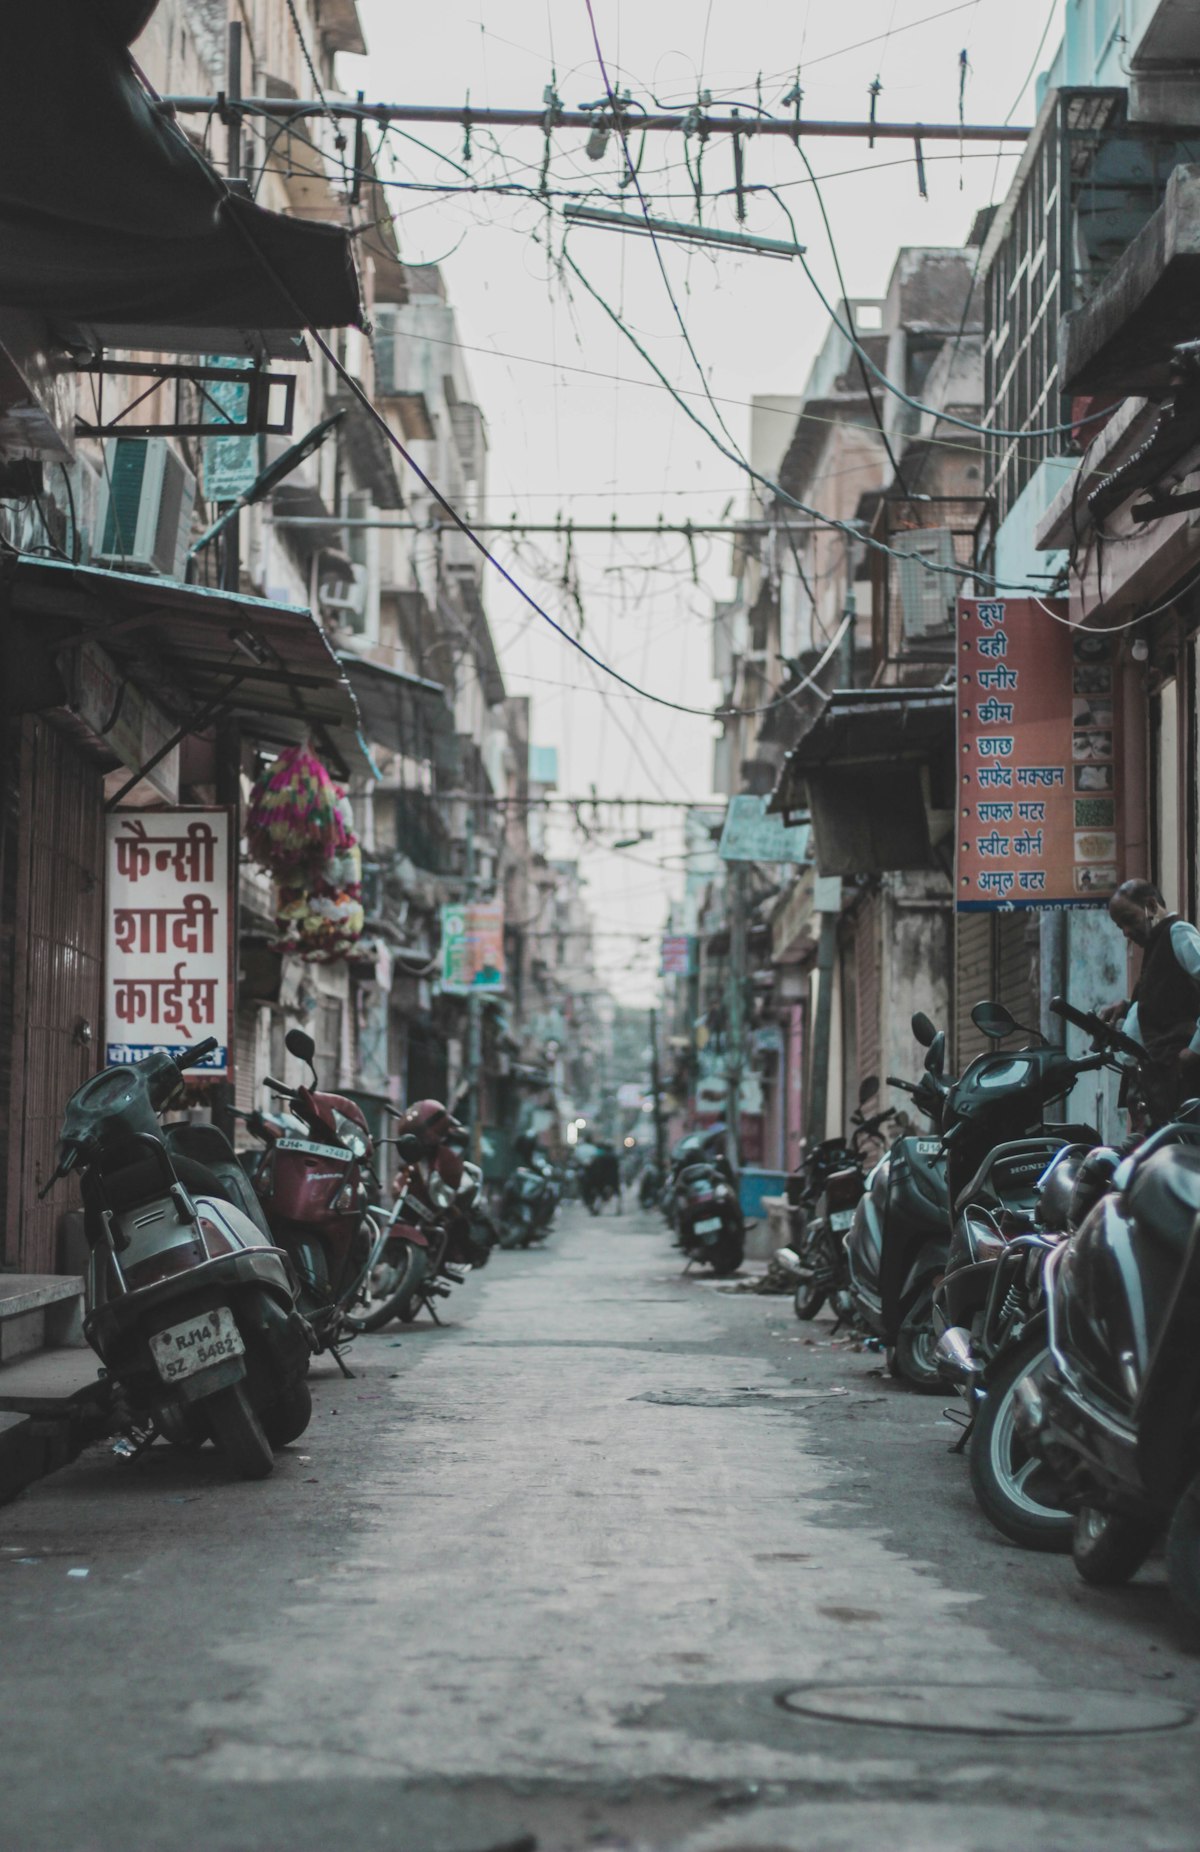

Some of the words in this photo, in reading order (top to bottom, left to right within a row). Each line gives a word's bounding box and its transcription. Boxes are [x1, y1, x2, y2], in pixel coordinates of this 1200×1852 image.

[978, 604, 1004, 627] दूध
[978, 631, 1007, 657] दही
[978, 665, 1017, 689] पनीर
[978, 698, 1013, 722] क्रीम
[978, 737, 1013, 756] छाछ
[978, 761, 1012, 786] सफेद
[1017, 767, 1064, 786] मक्खन
[978, 803, 1013, 821] सफल
[1019, 803, 1045, 820] मटर
[114, 820, 218, 882] फैन्सी
[978, 831, 1009, 856] स्वीट
[1014, 830, 1042, 855] कोर्न
[978, 872, 1014, 896] अमूल
[1019, 872, 1045, 889] बटर
[113, 893, 219, 953] शादी
[113, 962, 218, 1038] कार्ड्स
[175, 1326, 212, 1351] RJ14
[166, 1358, 188, 1377] SZ
[196, 1338, 235, 1363] 5482
